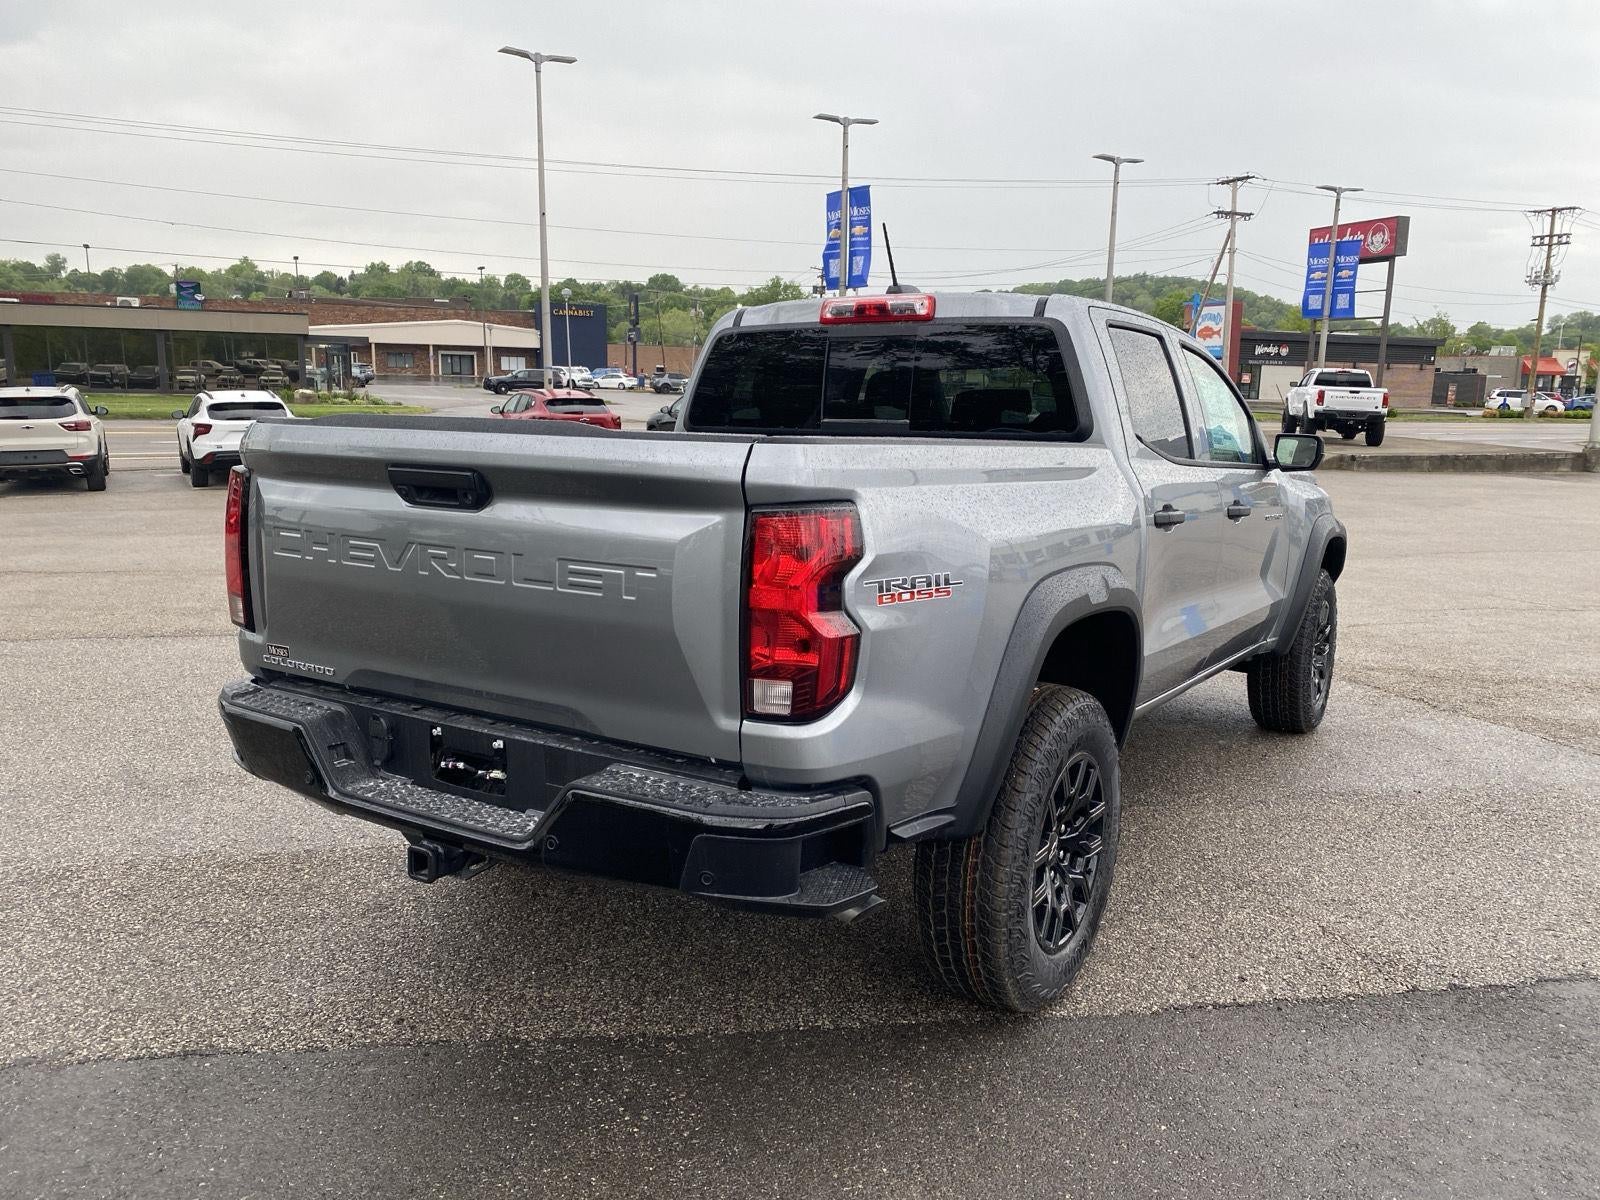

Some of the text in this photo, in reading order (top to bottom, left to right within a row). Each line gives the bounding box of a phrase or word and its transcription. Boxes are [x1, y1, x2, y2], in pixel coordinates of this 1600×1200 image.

[828, 211, 841, 221] MOS
[850, 206, 870, 217] MOSES
[1336, 255, 1359, 264] MOSES
[553, 308, 594, 317] CANNABIST
[1255, 344, 1279, 356] Wendy's
[273, 526, 658, 600] CHEVROLET
[863, 572, 963, 594] TRAIL
[877, 586, 952, 606] BOSS
[268, 645, 289, 657] MOSES
[262, 654, 335, 675] COLORADO
